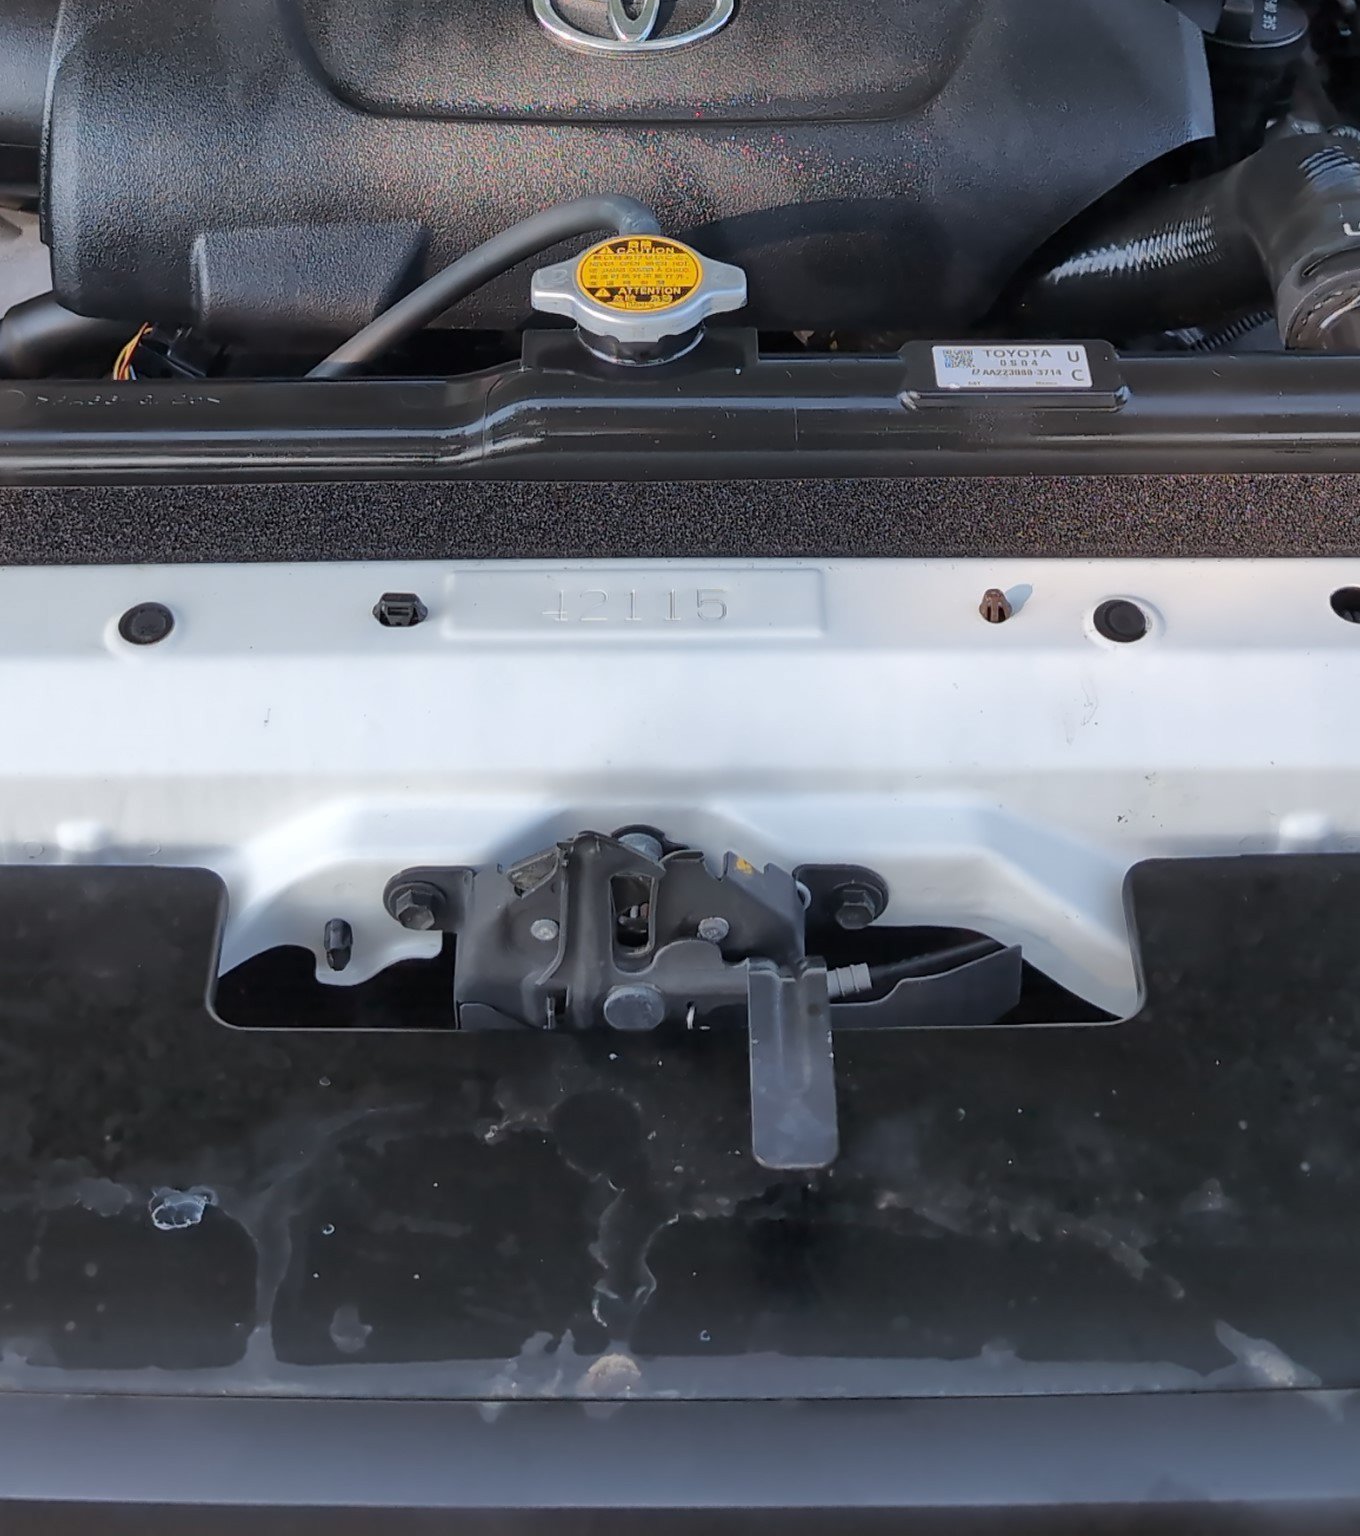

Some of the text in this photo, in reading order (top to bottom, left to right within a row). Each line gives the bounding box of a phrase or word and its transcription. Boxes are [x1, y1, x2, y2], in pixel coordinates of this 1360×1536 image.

[618, 287, 682, 295] ATTENTION
[982, 349, 1080, 363] TOYOTA U
[1071, 369, 1085, 382] C
